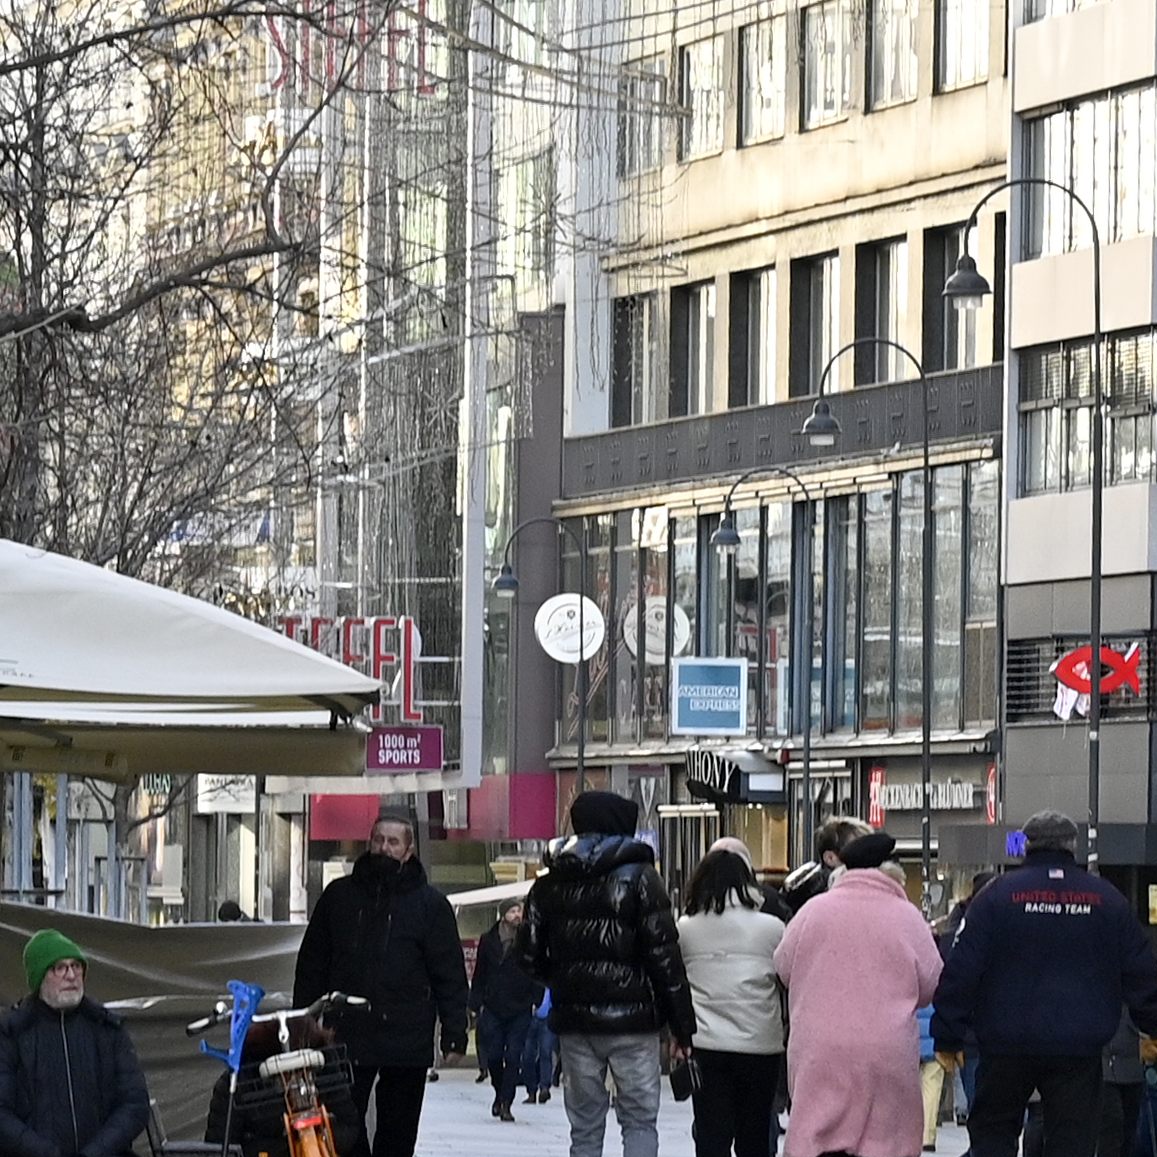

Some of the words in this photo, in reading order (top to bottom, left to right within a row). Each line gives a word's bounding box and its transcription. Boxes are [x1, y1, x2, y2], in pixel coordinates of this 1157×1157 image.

[679, 685, 738, 697] AMERICAN
[690, 699, 740, 711] EXPRESS
[378, 734, 405, 748] 1000
[378, 749, 421, 765] SPORTS
[1012, 891, 1056, 902] UNITED
[1025, 902, 1062, 914] RACING
[1064, 903, 1091, 915] TEAM
